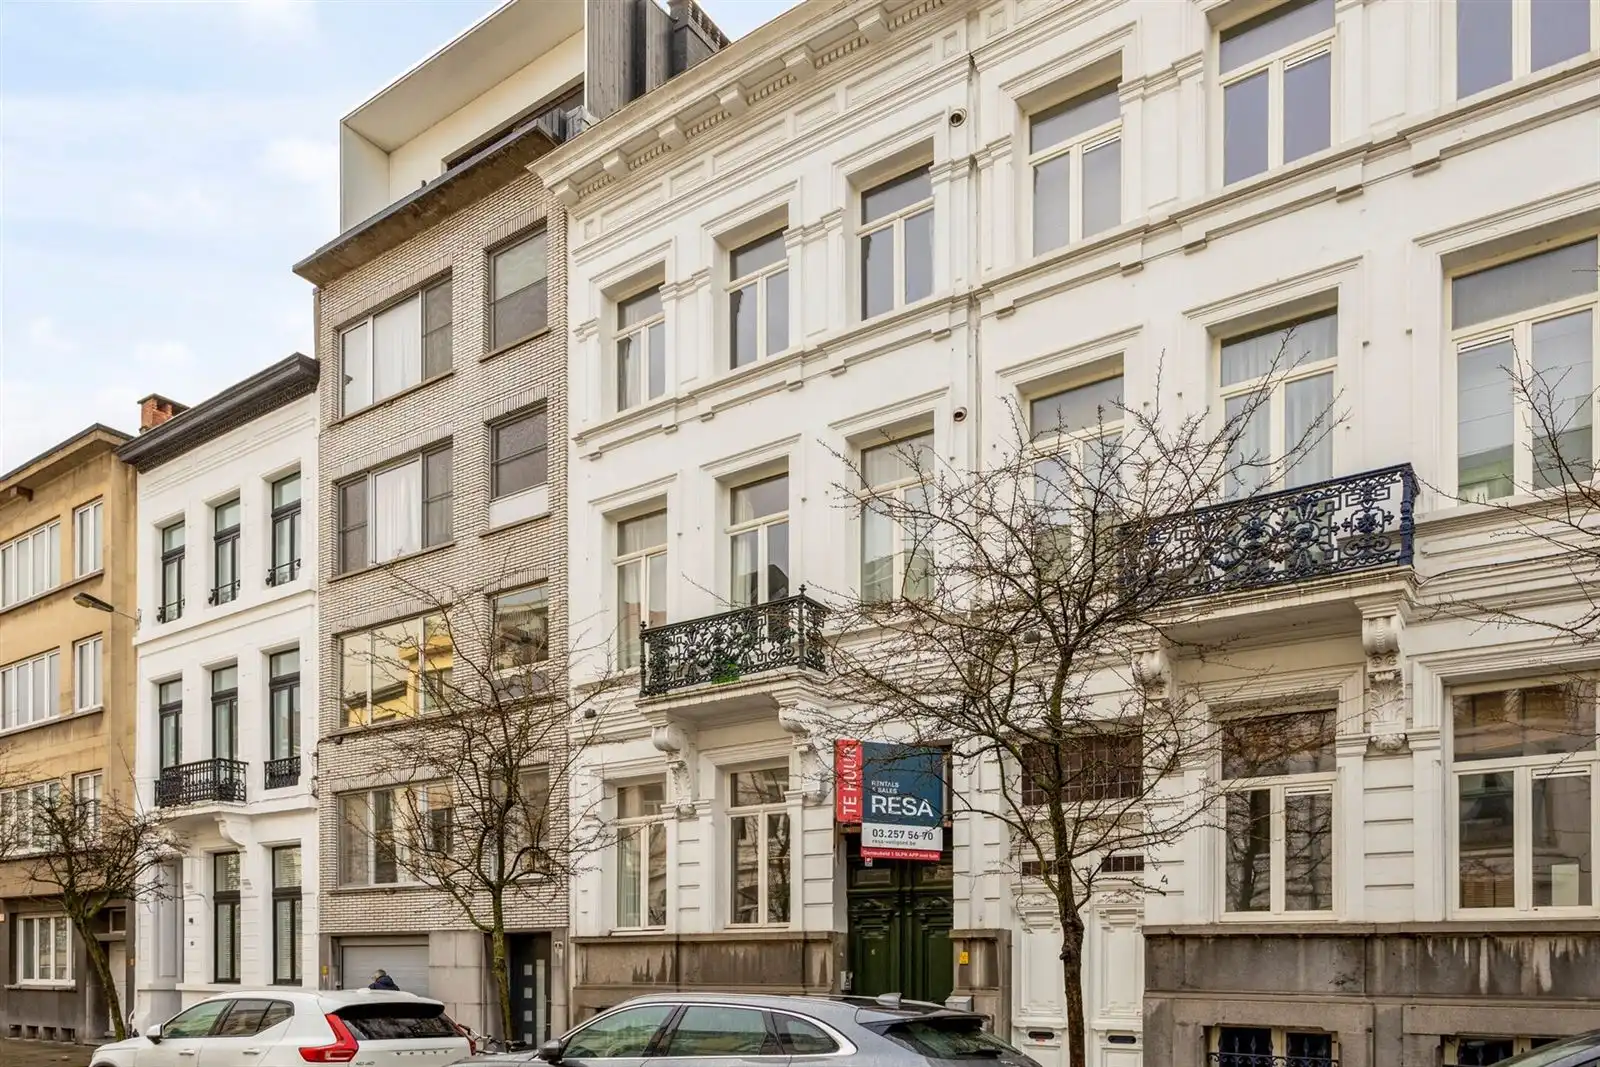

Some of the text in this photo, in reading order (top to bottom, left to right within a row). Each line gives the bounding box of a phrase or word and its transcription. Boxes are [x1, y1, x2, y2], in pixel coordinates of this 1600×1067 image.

[843, 747, 857, 815] TE HUUR
[871, 780, 900, 788] RENTALS
[871, 795, 934, 817] RESA
[872, 828, 934, 841] 03.257 56 70
